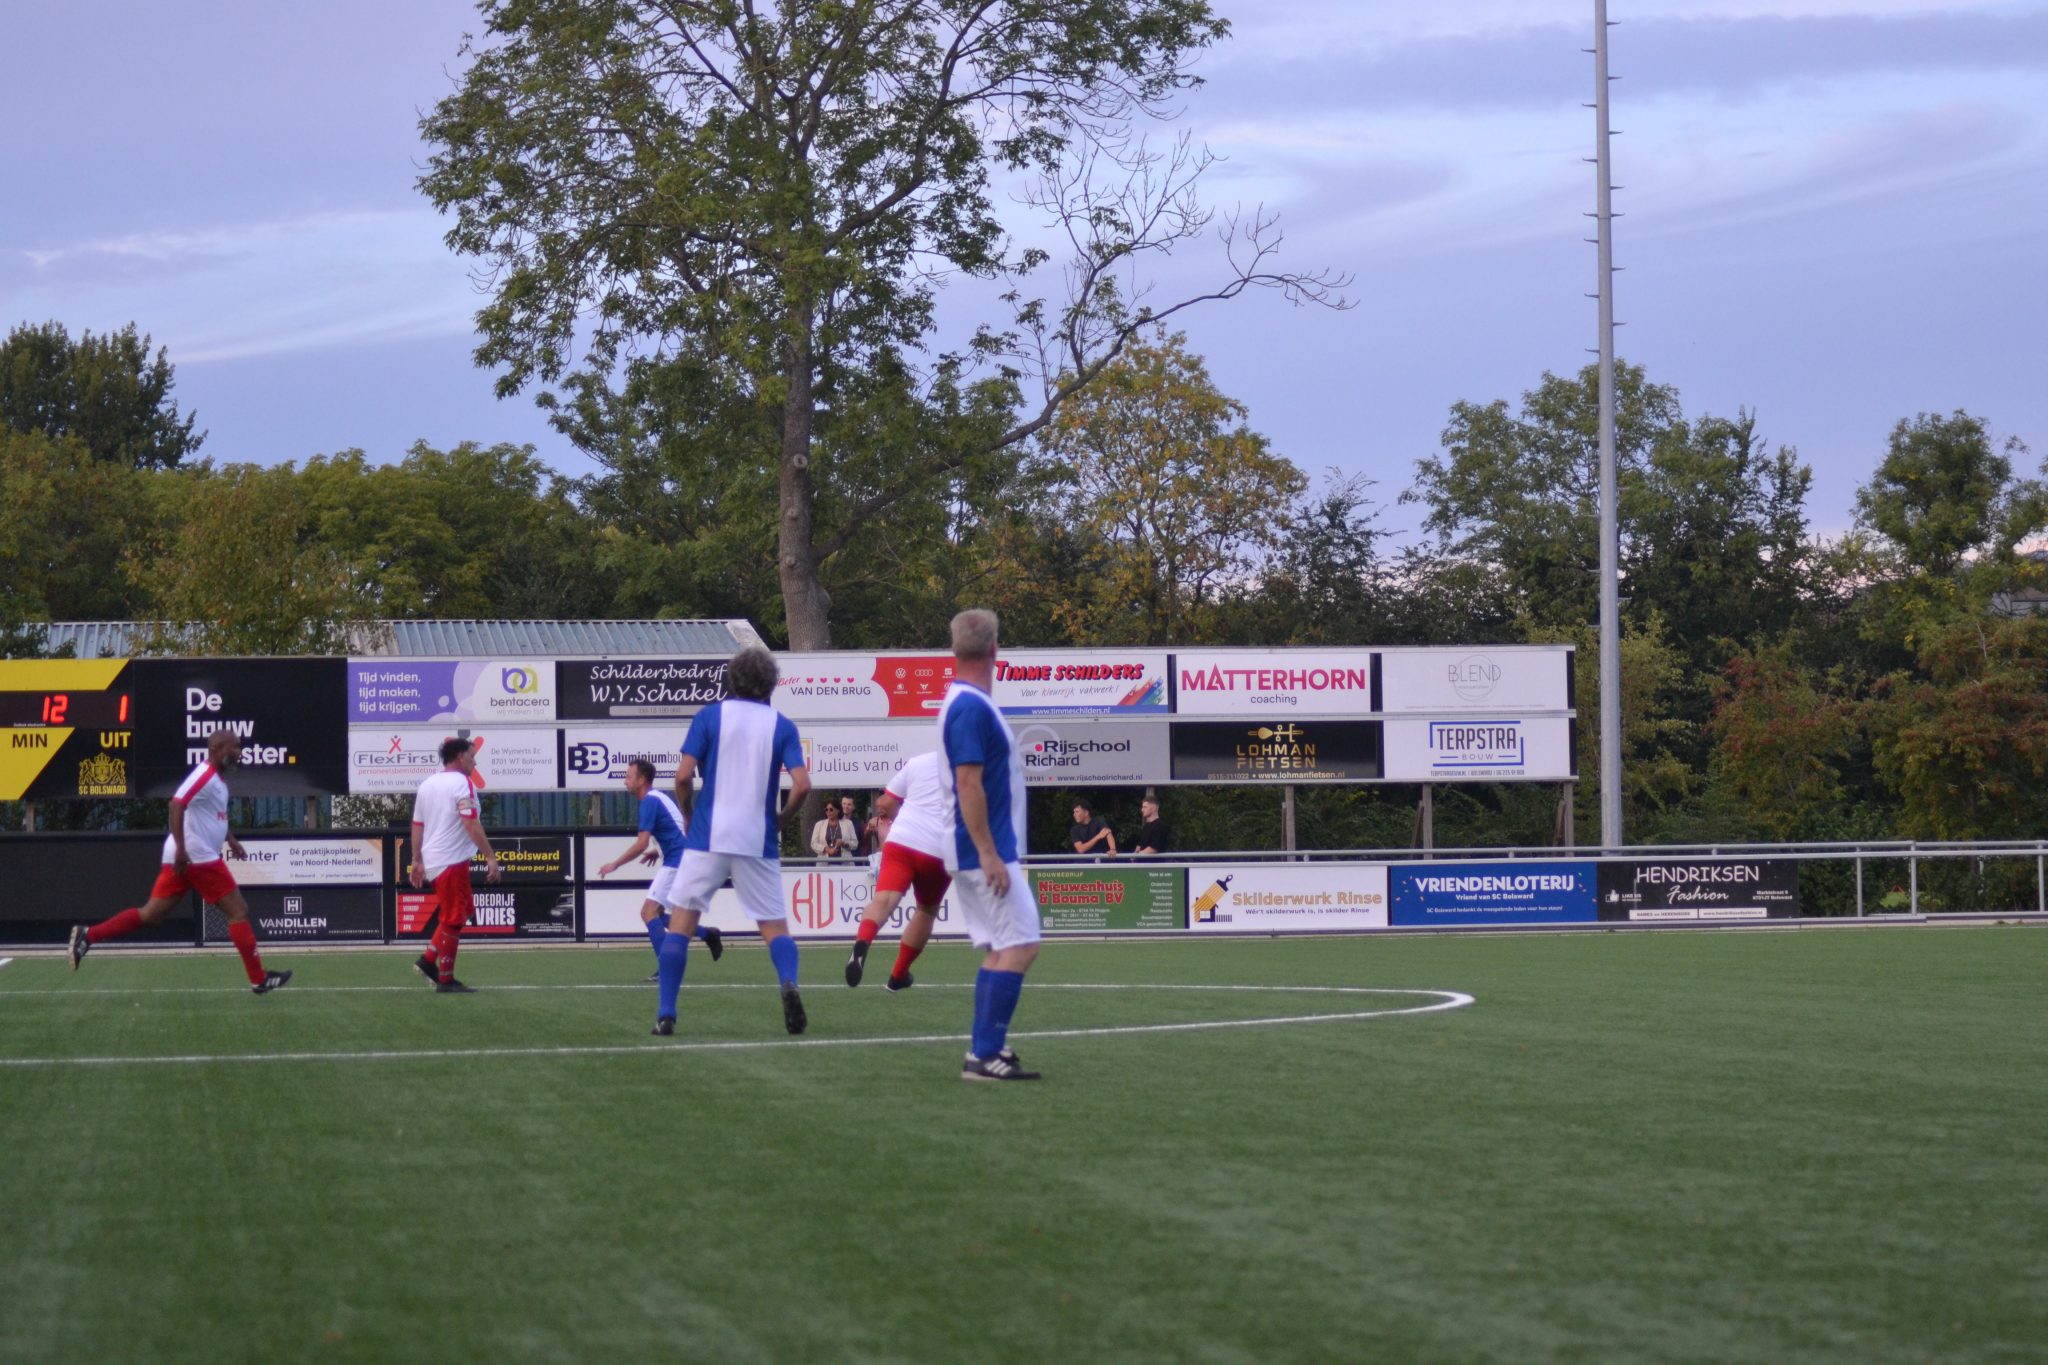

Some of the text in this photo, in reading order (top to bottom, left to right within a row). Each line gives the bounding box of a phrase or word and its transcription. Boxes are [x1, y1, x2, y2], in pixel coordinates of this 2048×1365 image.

[590, 663, 728, 682] Schildersbedrijf
[994, 661, 1145, 681] TIMME SCHILDERS
[1181, 663, 1366, 691] MATTERHORN
[1447, 664, 1502, 682] BLEND
[358, 672, 421, 684] Tijd vinden,
[358, 687, 421, 699] tijd maken,
[791, 686, 871, 696] VAN DEN BRUG
[1021, 689, 1038, 697] Voor
[1042, 688, 1074, 698] kleurrijk
[186, 687, 222, 711] De
[490, 697, 550, 706] bentacera
[1250, 694, 1298, 705] coaching
[42, 694, 69, 723] 12
[119, 694, 129, 722] 1
[358, 701, 420, 713] tijd krijgen.
[1031, 706, 1111, 715] www.timmeschilders.nl
[12, 734, 48, 748] MIN
[100, 731, 131, 748] UIT
[1437, 728, 1517, 750] TERPSTRA
[817, 743, 899, 755] Tegelgroothandel
[1043, 739, 1131, 755] Rijschool
[1236, 744, 1316, 756] LOHMAN
[358, 752, 437, 765] FlexFirst
[1025, 754, 1080, 767] Richard
[1237, 757, 1316, 769] FIETSEN
[817, 758, 859, 773] Julius
[864, 760, 889, 772] van
[1056, 774, 1143, 782] www.rijschoolrichard.nl
[1258, 771, 1346, 779] www.lohmanfietsen.nl
[79, 785, 127, 795] SC BOLSWARD
[302, 847, 361, 857] praktijkopleider
[290, 858, 373, 867] van Noord-Nederland!
[1636, 865, 1760, 884] HENDRIKSEN
[1038, 879, 1125, 893] Nieuwenhuis
[1415, 874, 1574, 892] VRIENDENLOTERIJ
[1039, 892, 1124, 905] & Bouma BV
[1232, 891, 1382, 906] Skilderwurk Rinse
[1455, 893, 1477, 901] Vriend
[1666, 884, 1729, 905] Fashion
[259, 917, 327, 928] VANDILLEN
[475, 907, 516, 926] VRIES
